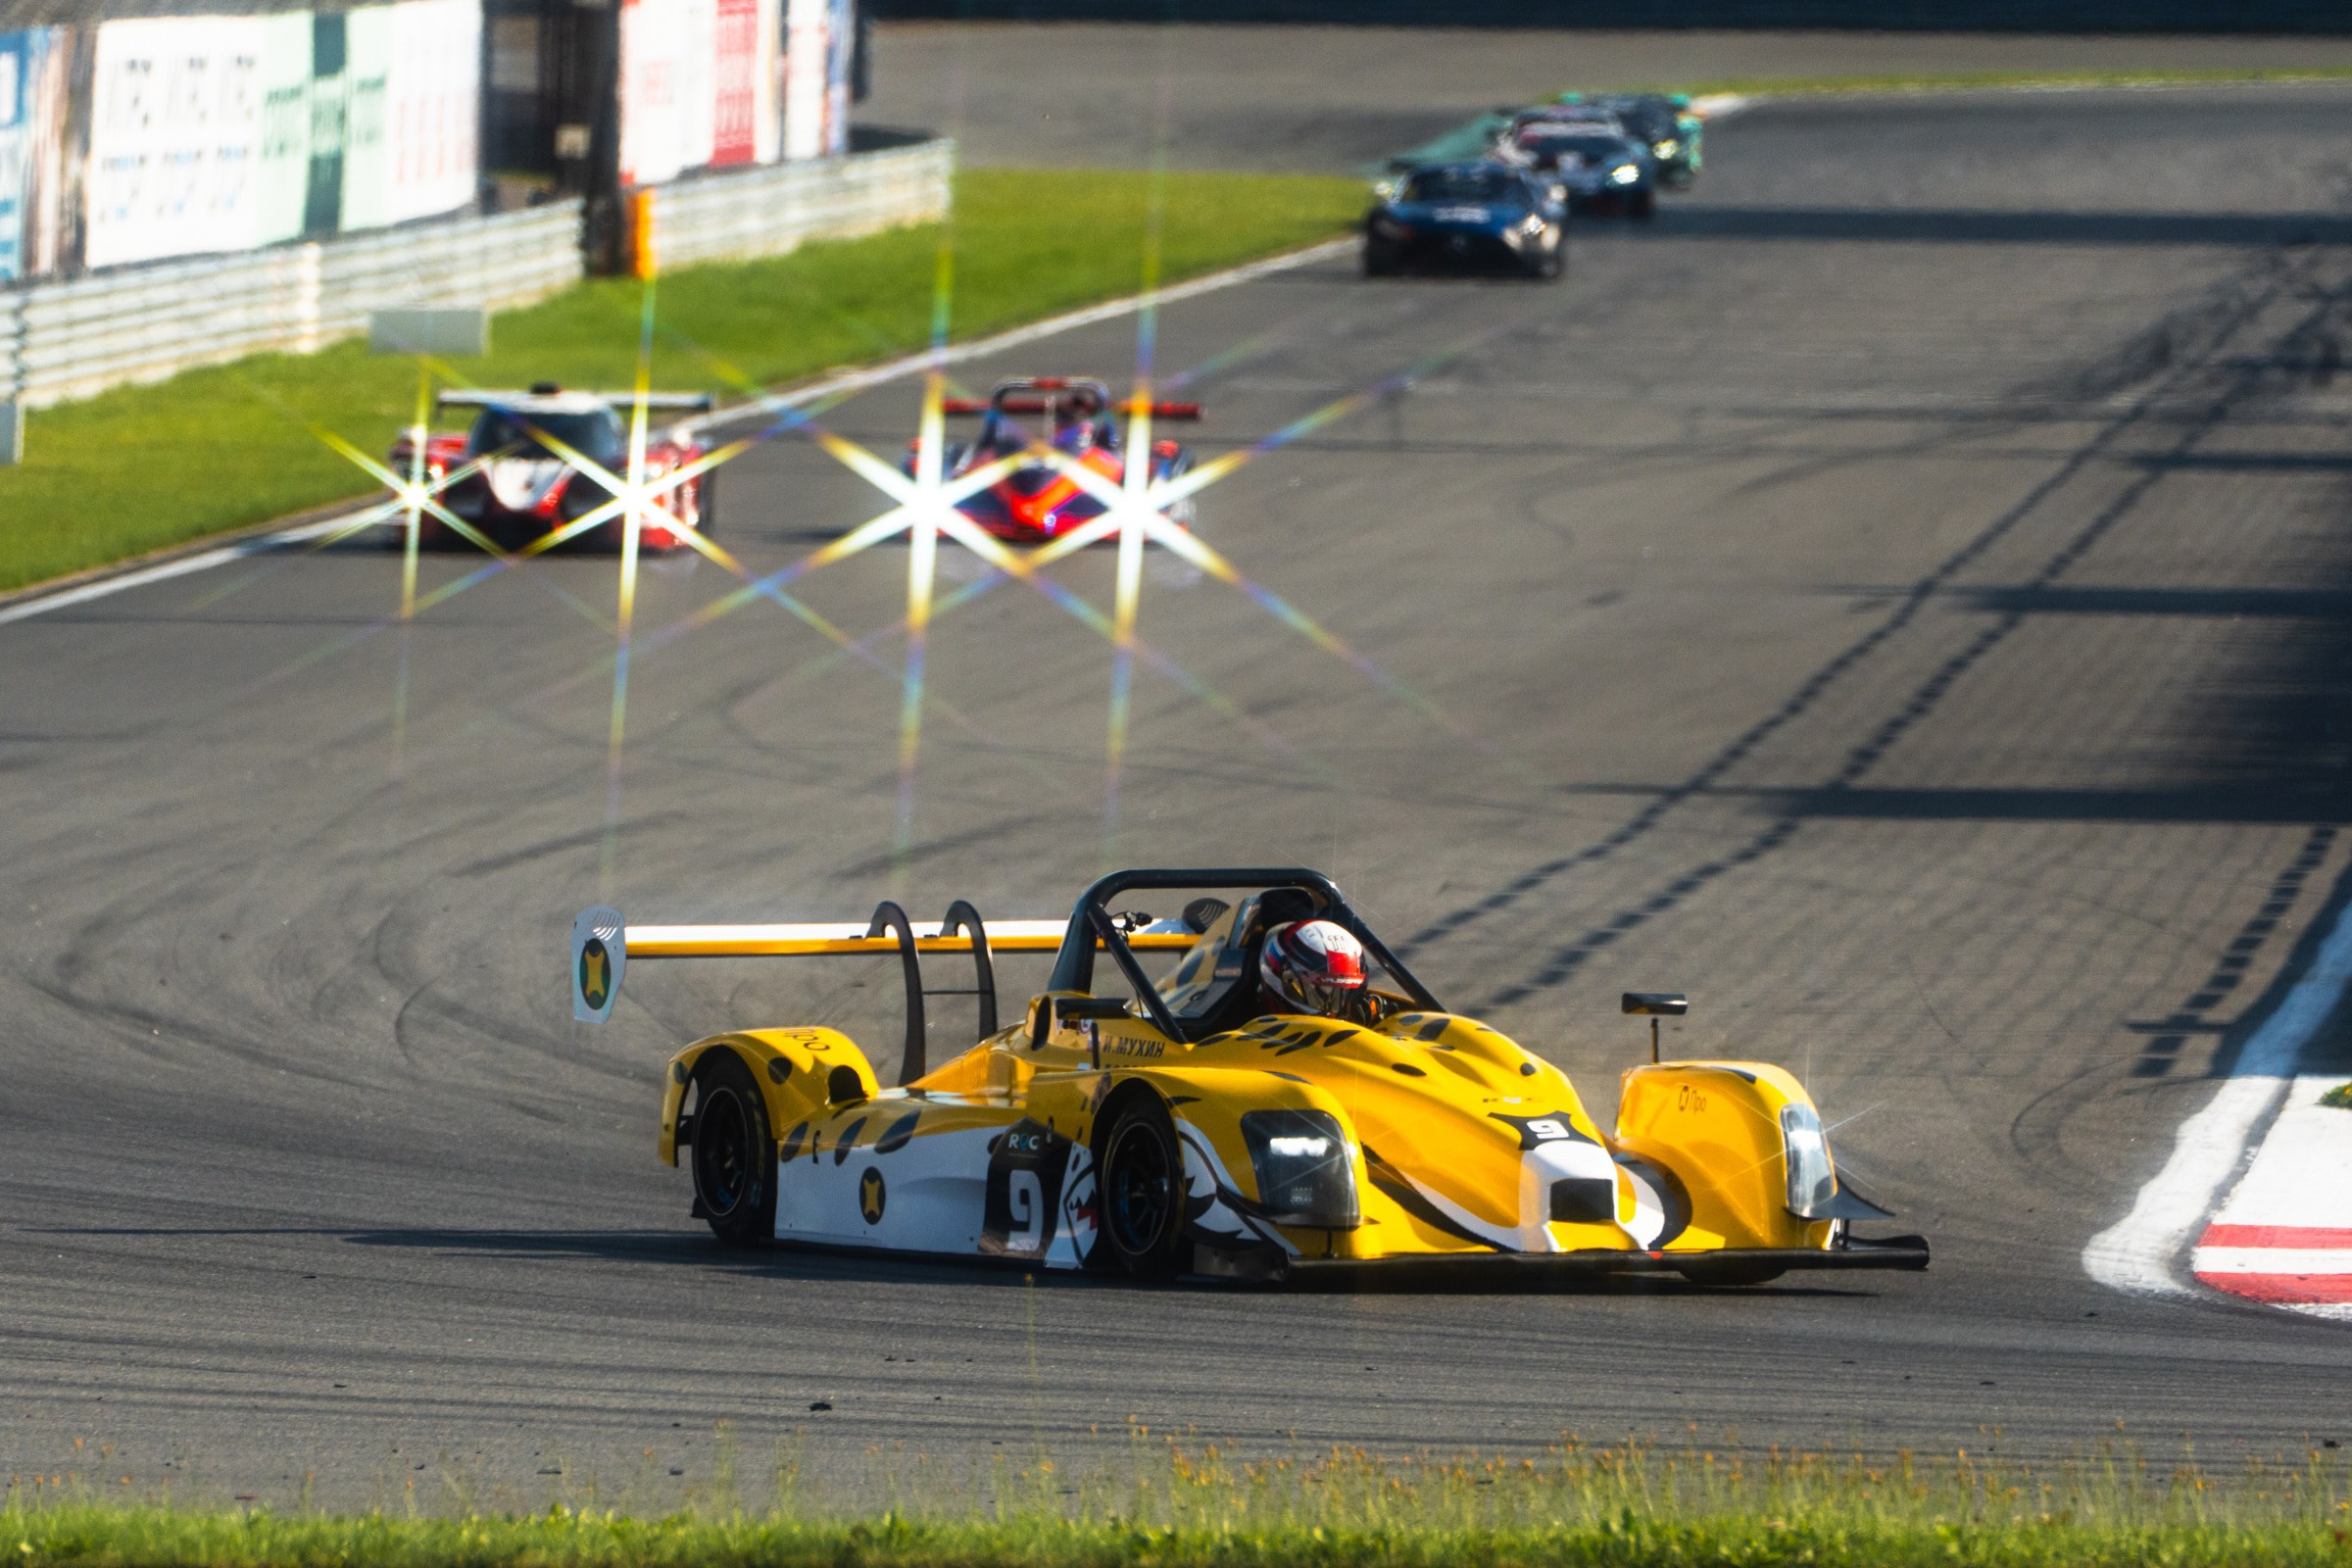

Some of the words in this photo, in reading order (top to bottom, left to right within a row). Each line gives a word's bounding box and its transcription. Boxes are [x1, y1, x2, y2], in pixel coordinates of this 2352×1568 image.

[1102, 1035, 1166, 1058] И.МУХИН
[1526, 1119, 1570, 1140] 9
[1005, 1169, 1045, 1251] 9
